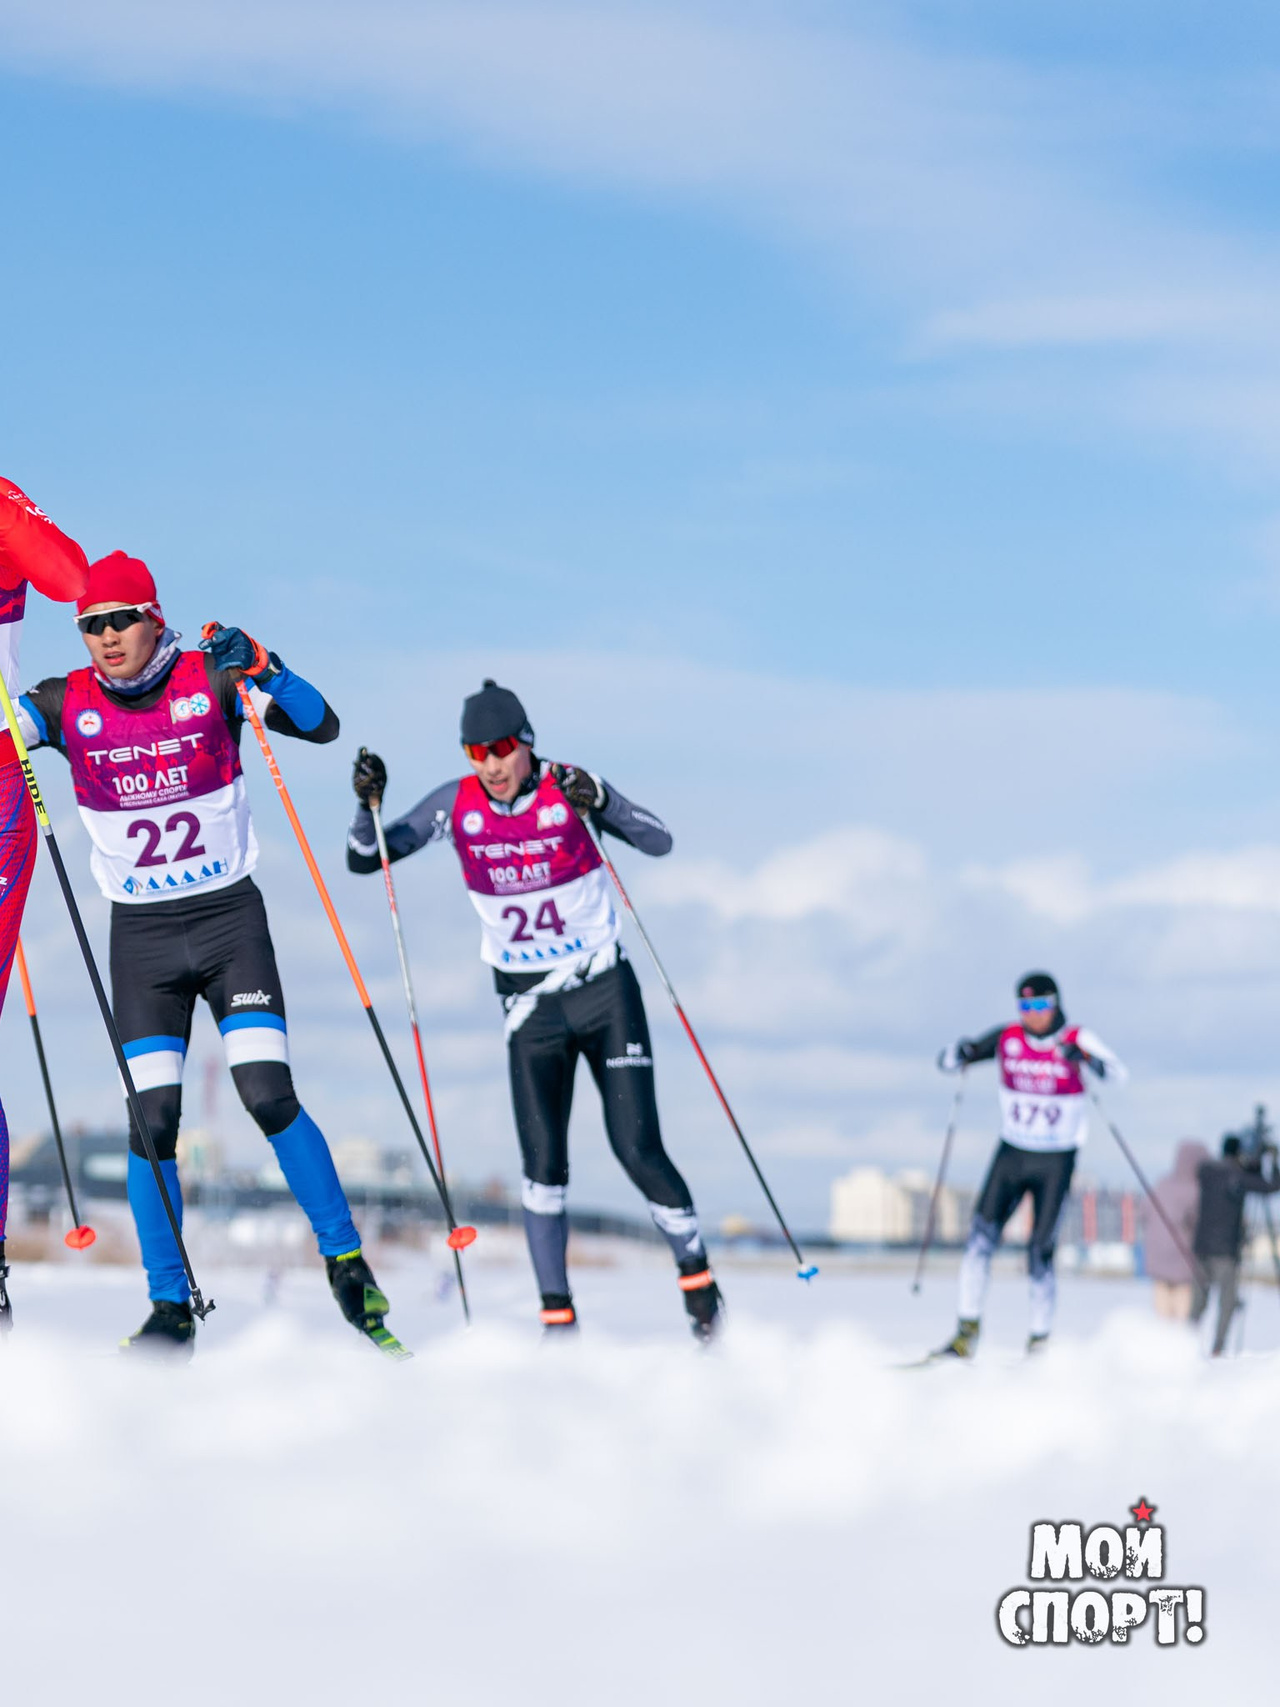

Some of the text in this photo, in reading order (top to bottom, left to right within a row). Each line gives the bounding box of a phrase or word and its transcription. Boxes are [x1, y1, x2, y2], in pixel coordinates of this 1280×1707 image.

[86, 732, 204, 766] TENET
[20, 758, 46, 815] HIDE
[111, 764, 189, 795] 100 ЛЕТ
[120, 784, 188, 802] ЛЫЖНОМУ СПОРТУ
[127, 811, 207, 868] 22
[468, 836, 564, 860] TENET
[487, 861, 551, 884] 100 ЛЕТ
[501, 898, 566, 943] 24
